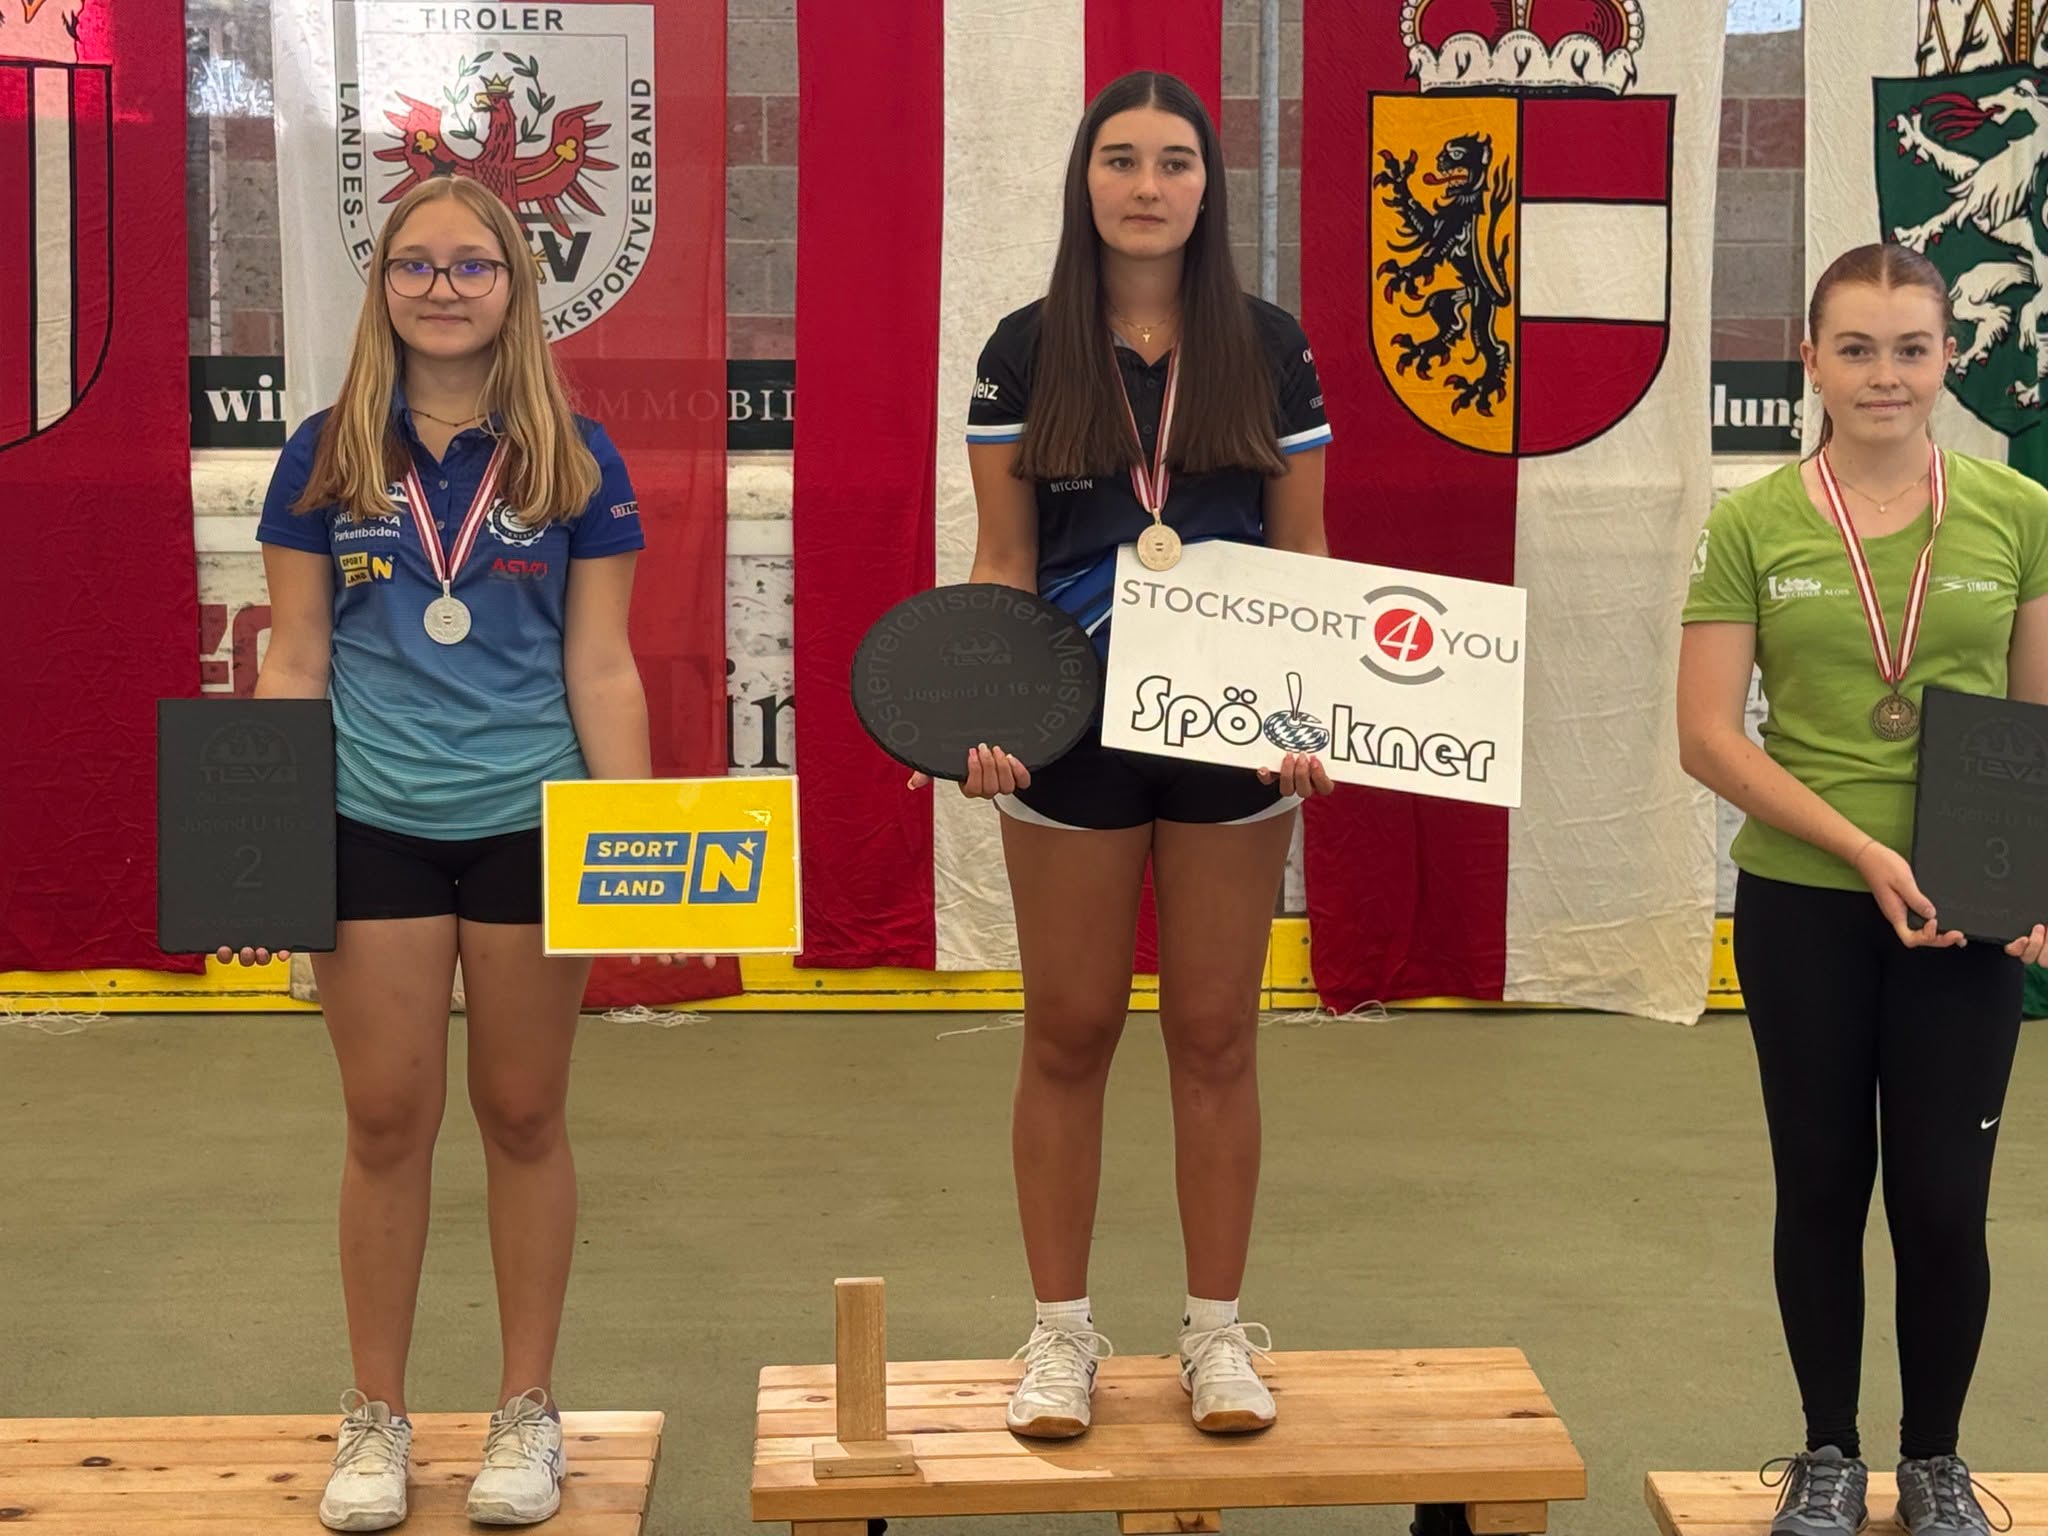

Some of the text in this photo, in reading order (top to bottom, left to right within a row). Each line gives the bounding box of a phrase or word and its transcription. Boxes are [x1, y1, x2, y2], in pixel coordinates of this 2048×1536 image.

[420, 8, 563, 30] TIROLER
[1050, 479, 1094, 493] BITCOIN
[1121, 579, 1367, 640] STOCKSPORT
[1440, 628, 1520, 664] YOU
[1033, 626, 1090, 743] Meister
[232, 845, 263, 889] 2
[597, 840, 754, 894] SPORT N
[1983, 836, 2010, 880] 3
[599, 880, 666, 897] LAND
